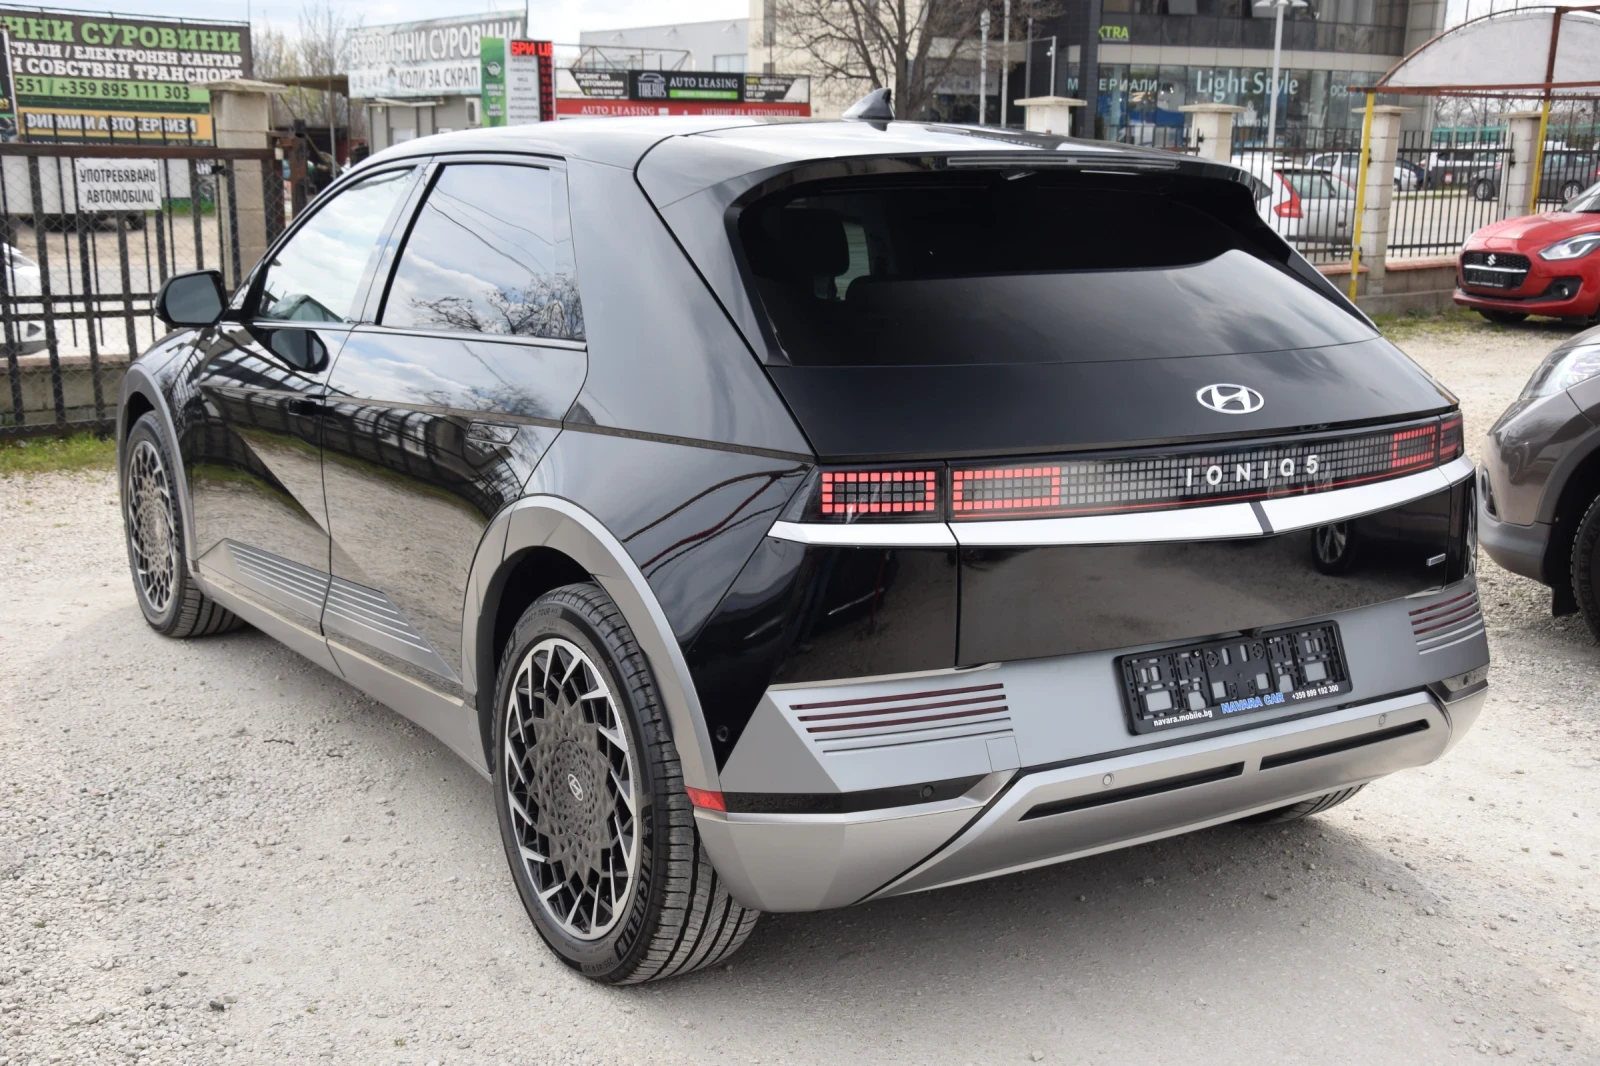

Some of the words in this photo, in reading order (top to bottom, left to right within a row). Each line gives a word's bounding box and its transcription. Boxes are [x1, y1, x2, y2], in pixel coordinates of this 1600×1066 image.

[0, 16, 75, 42] ЧНИ
[81, 22, 241, 53] СУРОВИНИ
[73, 46, 178, 65] ЕЛЕКТРОНЕН
[181, 52, 242, 68] КАНТАР
[351, 31, 427, 65] ВТОРИЧНИ
[26, 58, 131, 79] СОБСТВЕН
[134, 65, 243, 83] ТРАНСПОРТ
[400, 70, 426, 89] КОЛИ
[428, 69, 442, 88] ЗА
[444, 66, 479, 88] СКРАП
[59, 81, 97, 95] +359
[102, 83, 128, 97] 895
[134, 85, 159, 98] 111
[164, 86, 190, 100] 303
[669, 77, 697, 88] AUTO
[698, 78, 738, 89] LEASING
[1196, 69, 1249, 103] Light
[581, 105, 609, 115] AUTO
[611, 106, 655, 116] LEASING
[80, 168, 156, 183] УПОТРЕБЯВАНИ
[86, 189, 154, 204] АВТОМОБИЛИ
[1186, 457, 1295, 487] IONIQ
[1306, 454, 1318, 475] 5
[1221, 697, 1263, 714] NAVARA
[1264, 692, 1285, 706] CAR
[1292, 690, 1306, 700] +359
[1307, 688, 1317, 698] 899
[1329, 684, 1339, 693] 300
[1153, 709, 1213, 727] navara.mobile.bg
[616, 843, 652, 958] MICHELIN
